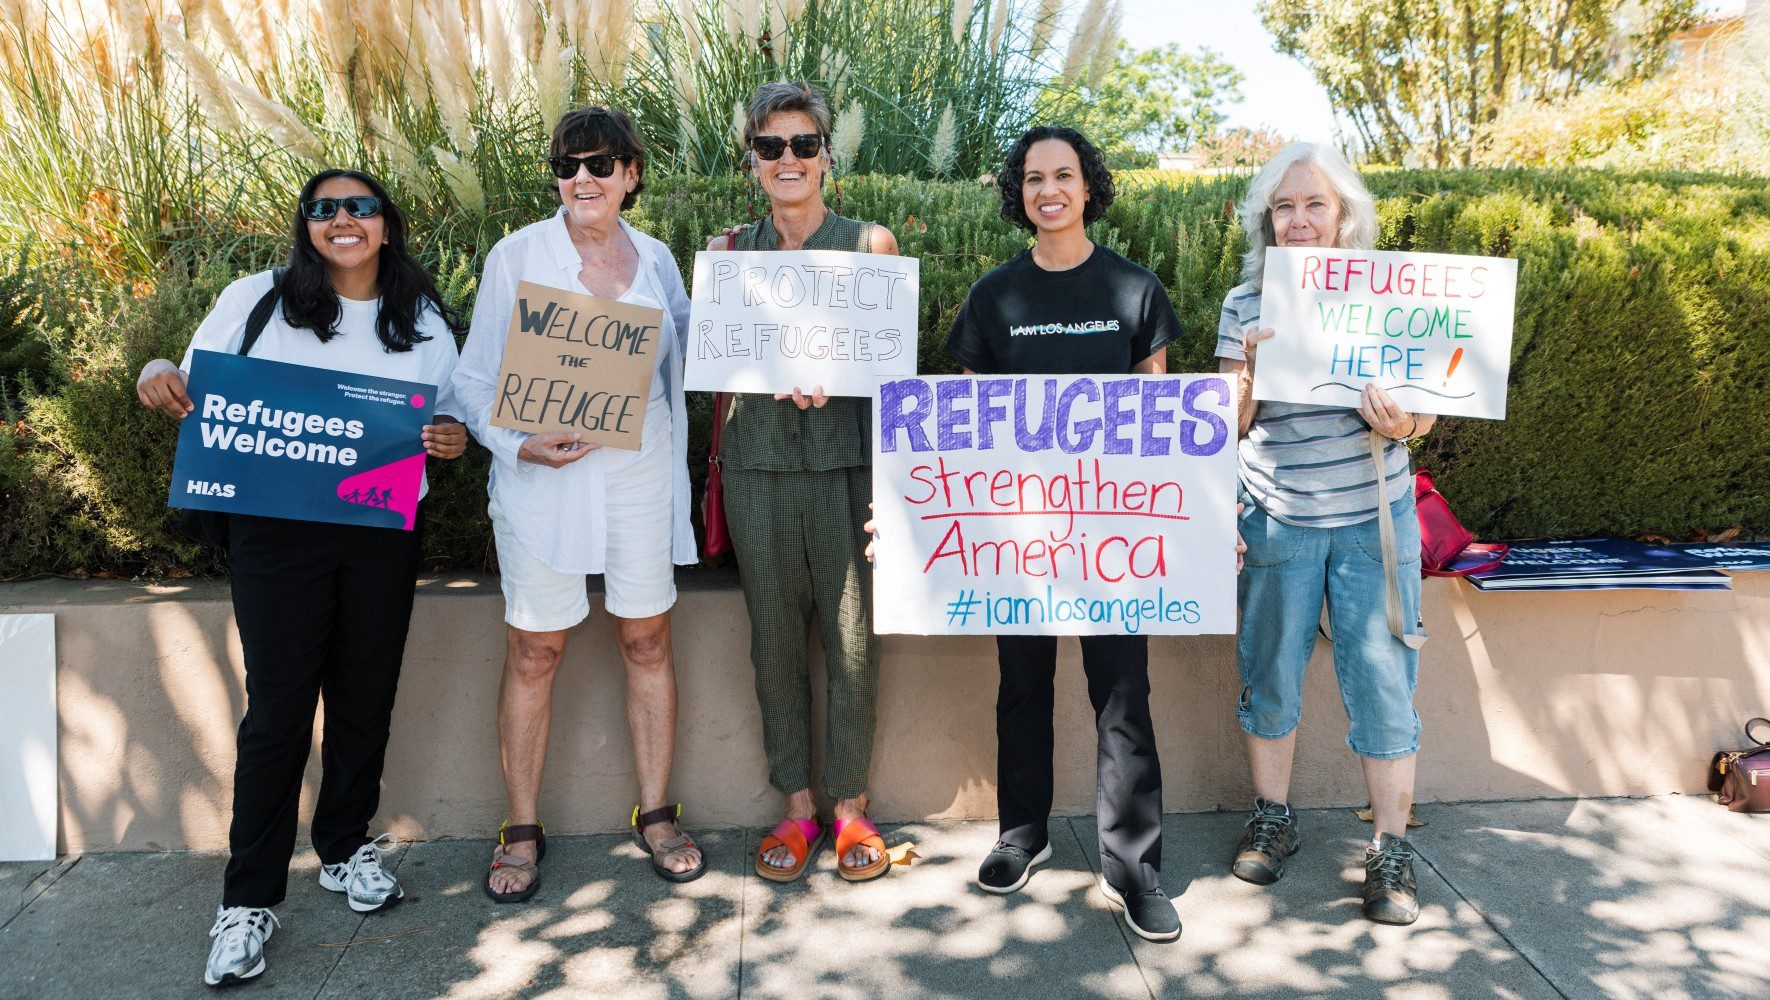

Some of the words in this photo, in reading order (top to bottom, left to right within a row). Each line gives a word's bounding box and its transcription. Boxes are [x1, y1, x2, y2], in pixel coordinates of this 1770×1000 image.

[710, 260, 908, 310] PROTECT
[1301, 255, 1488, 298] REFUGEES
[519, 299, 658, 355] WELCOME
[697, 320, 902, 361] REFUGEES
[1016, 325, 1037, 336] AM
[1040, 323, 1063, 335] LOS
[1065, 320, 1120, 334] ANGELES
[1318, 302, 1473, 339] WELCOME
[557, 354, 592, 368] THE
[1331, 344, 1425, 380] HERE
[337, 383, 367, 394] Welcome
[380, 390, 407, 399] stranger.
[344, 391, 369, 400] Protect
[380, 397, 406, 406] refugee.
[496, 373, 640, 434] REFUGEE
[202, 393, 364, 439] Refugees
[880, 377, 1231, 457] REFUGEES
[200, 422, 358, 466] Welcome
[186, 480, 236, 498] HIAS
[923, 520, 1166, 583] America
[946, 584, 1200, 633] #iamlosangeles
